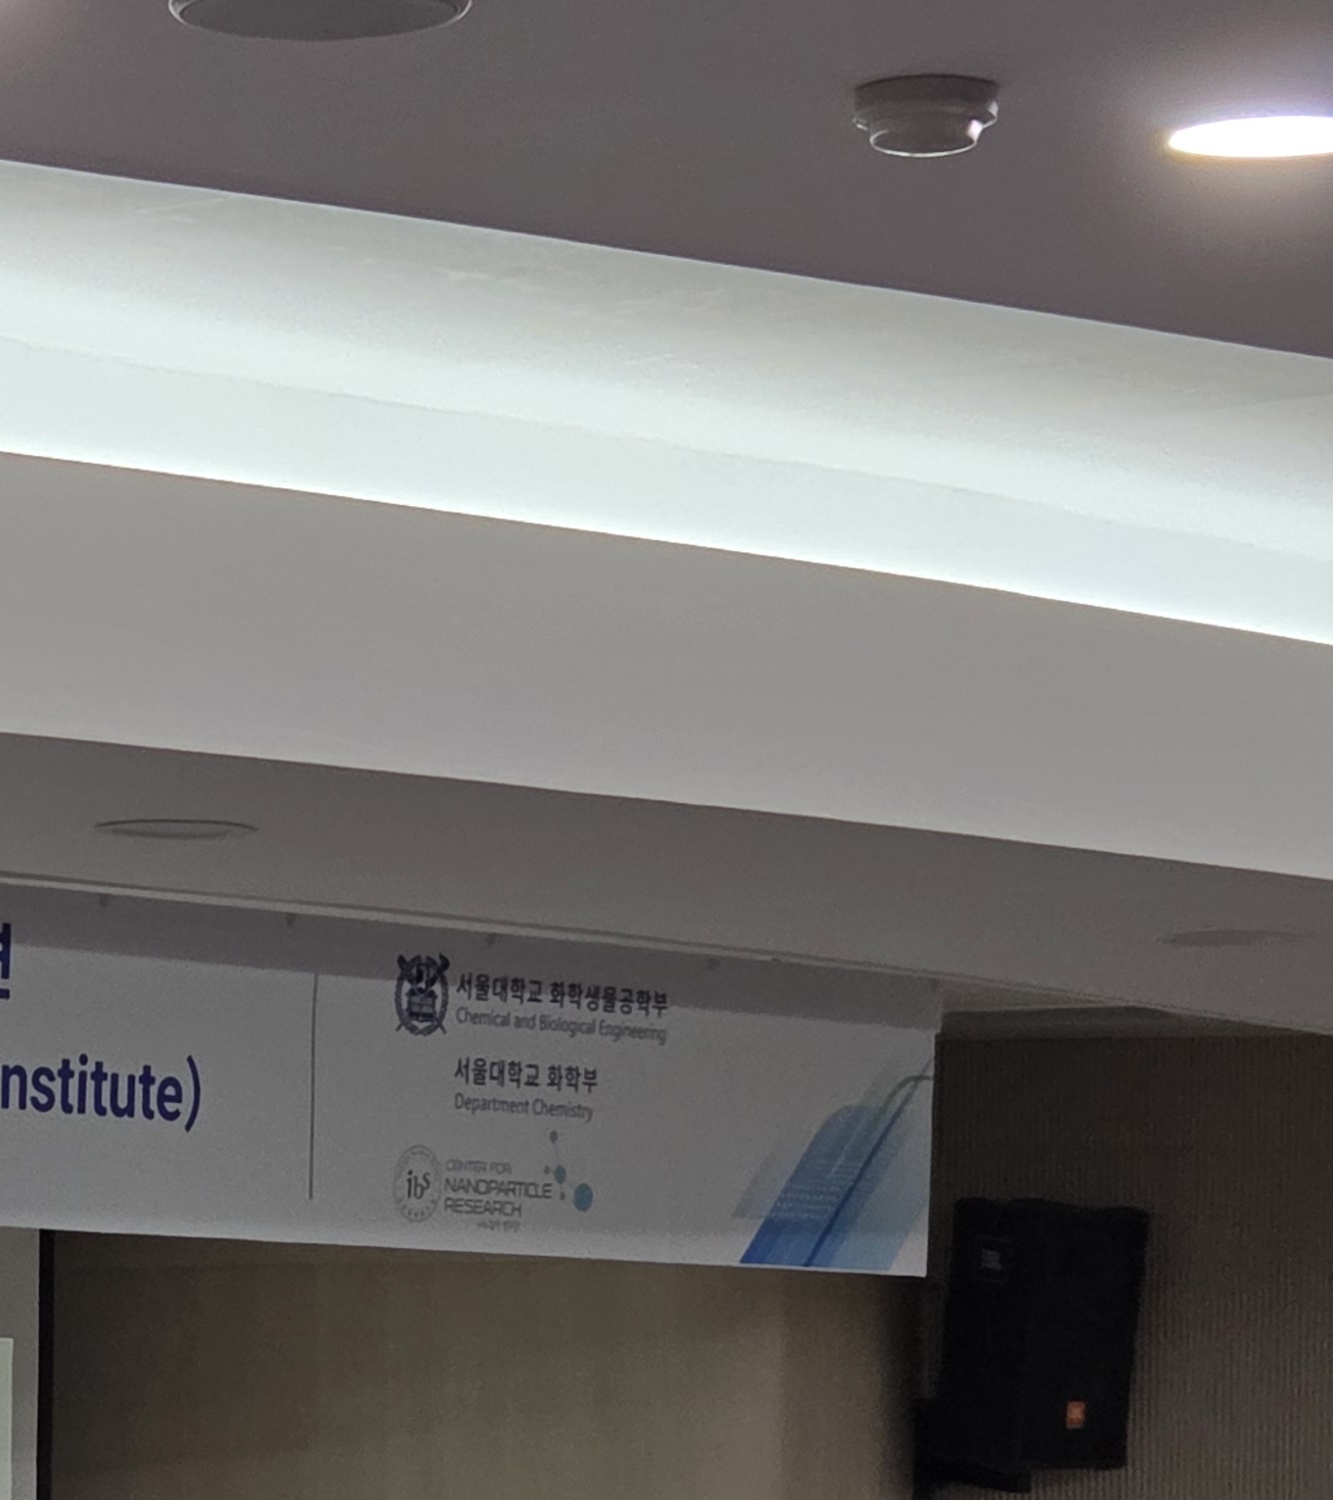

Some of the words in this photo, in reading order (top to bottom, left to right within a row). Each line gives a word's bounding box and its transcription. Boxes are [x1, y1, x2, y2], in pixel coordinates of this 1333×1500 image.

[456, 972, 542, 1006] 서울대학교
[549, 980, 668, 1018] 화학생물공학부
[454, 1056, 540, 1089] 서울대학교
[546, 1064, 598, 1094] 화학부
[454, 1092, 530, 1115] Department
